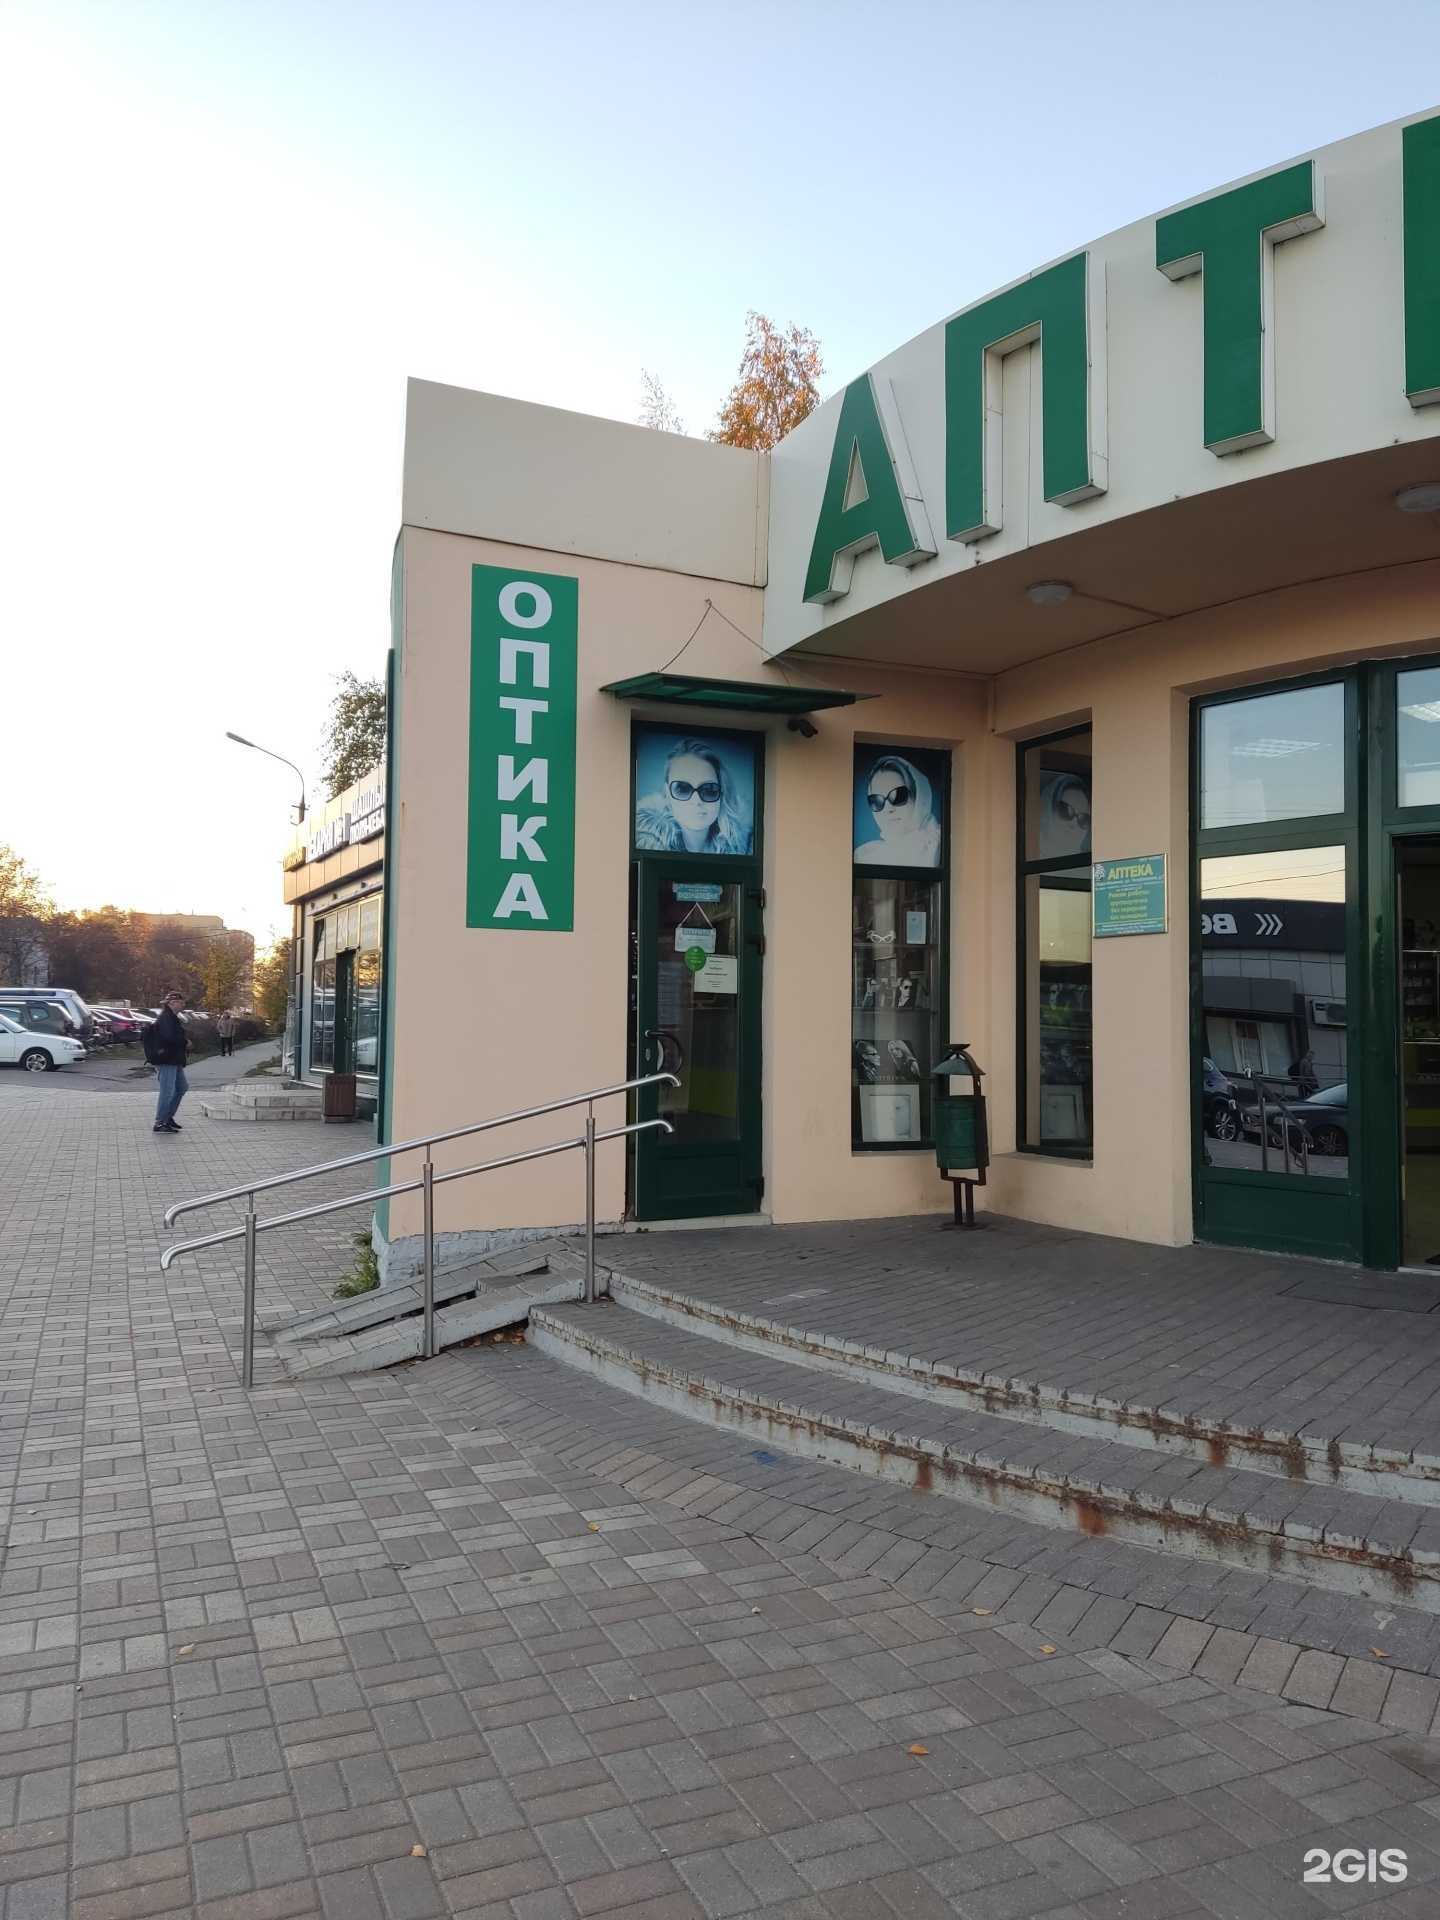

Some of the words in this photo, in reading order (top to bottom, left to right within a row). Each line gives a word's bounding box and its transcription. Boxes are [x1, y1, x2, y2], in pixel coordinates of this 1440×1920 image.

[492, 580, 553, 921] ОПТИКА
[352, 780, 385, 822] ШАШЛЫ
[1108, 864, 1153, 880] АПТЕКА
